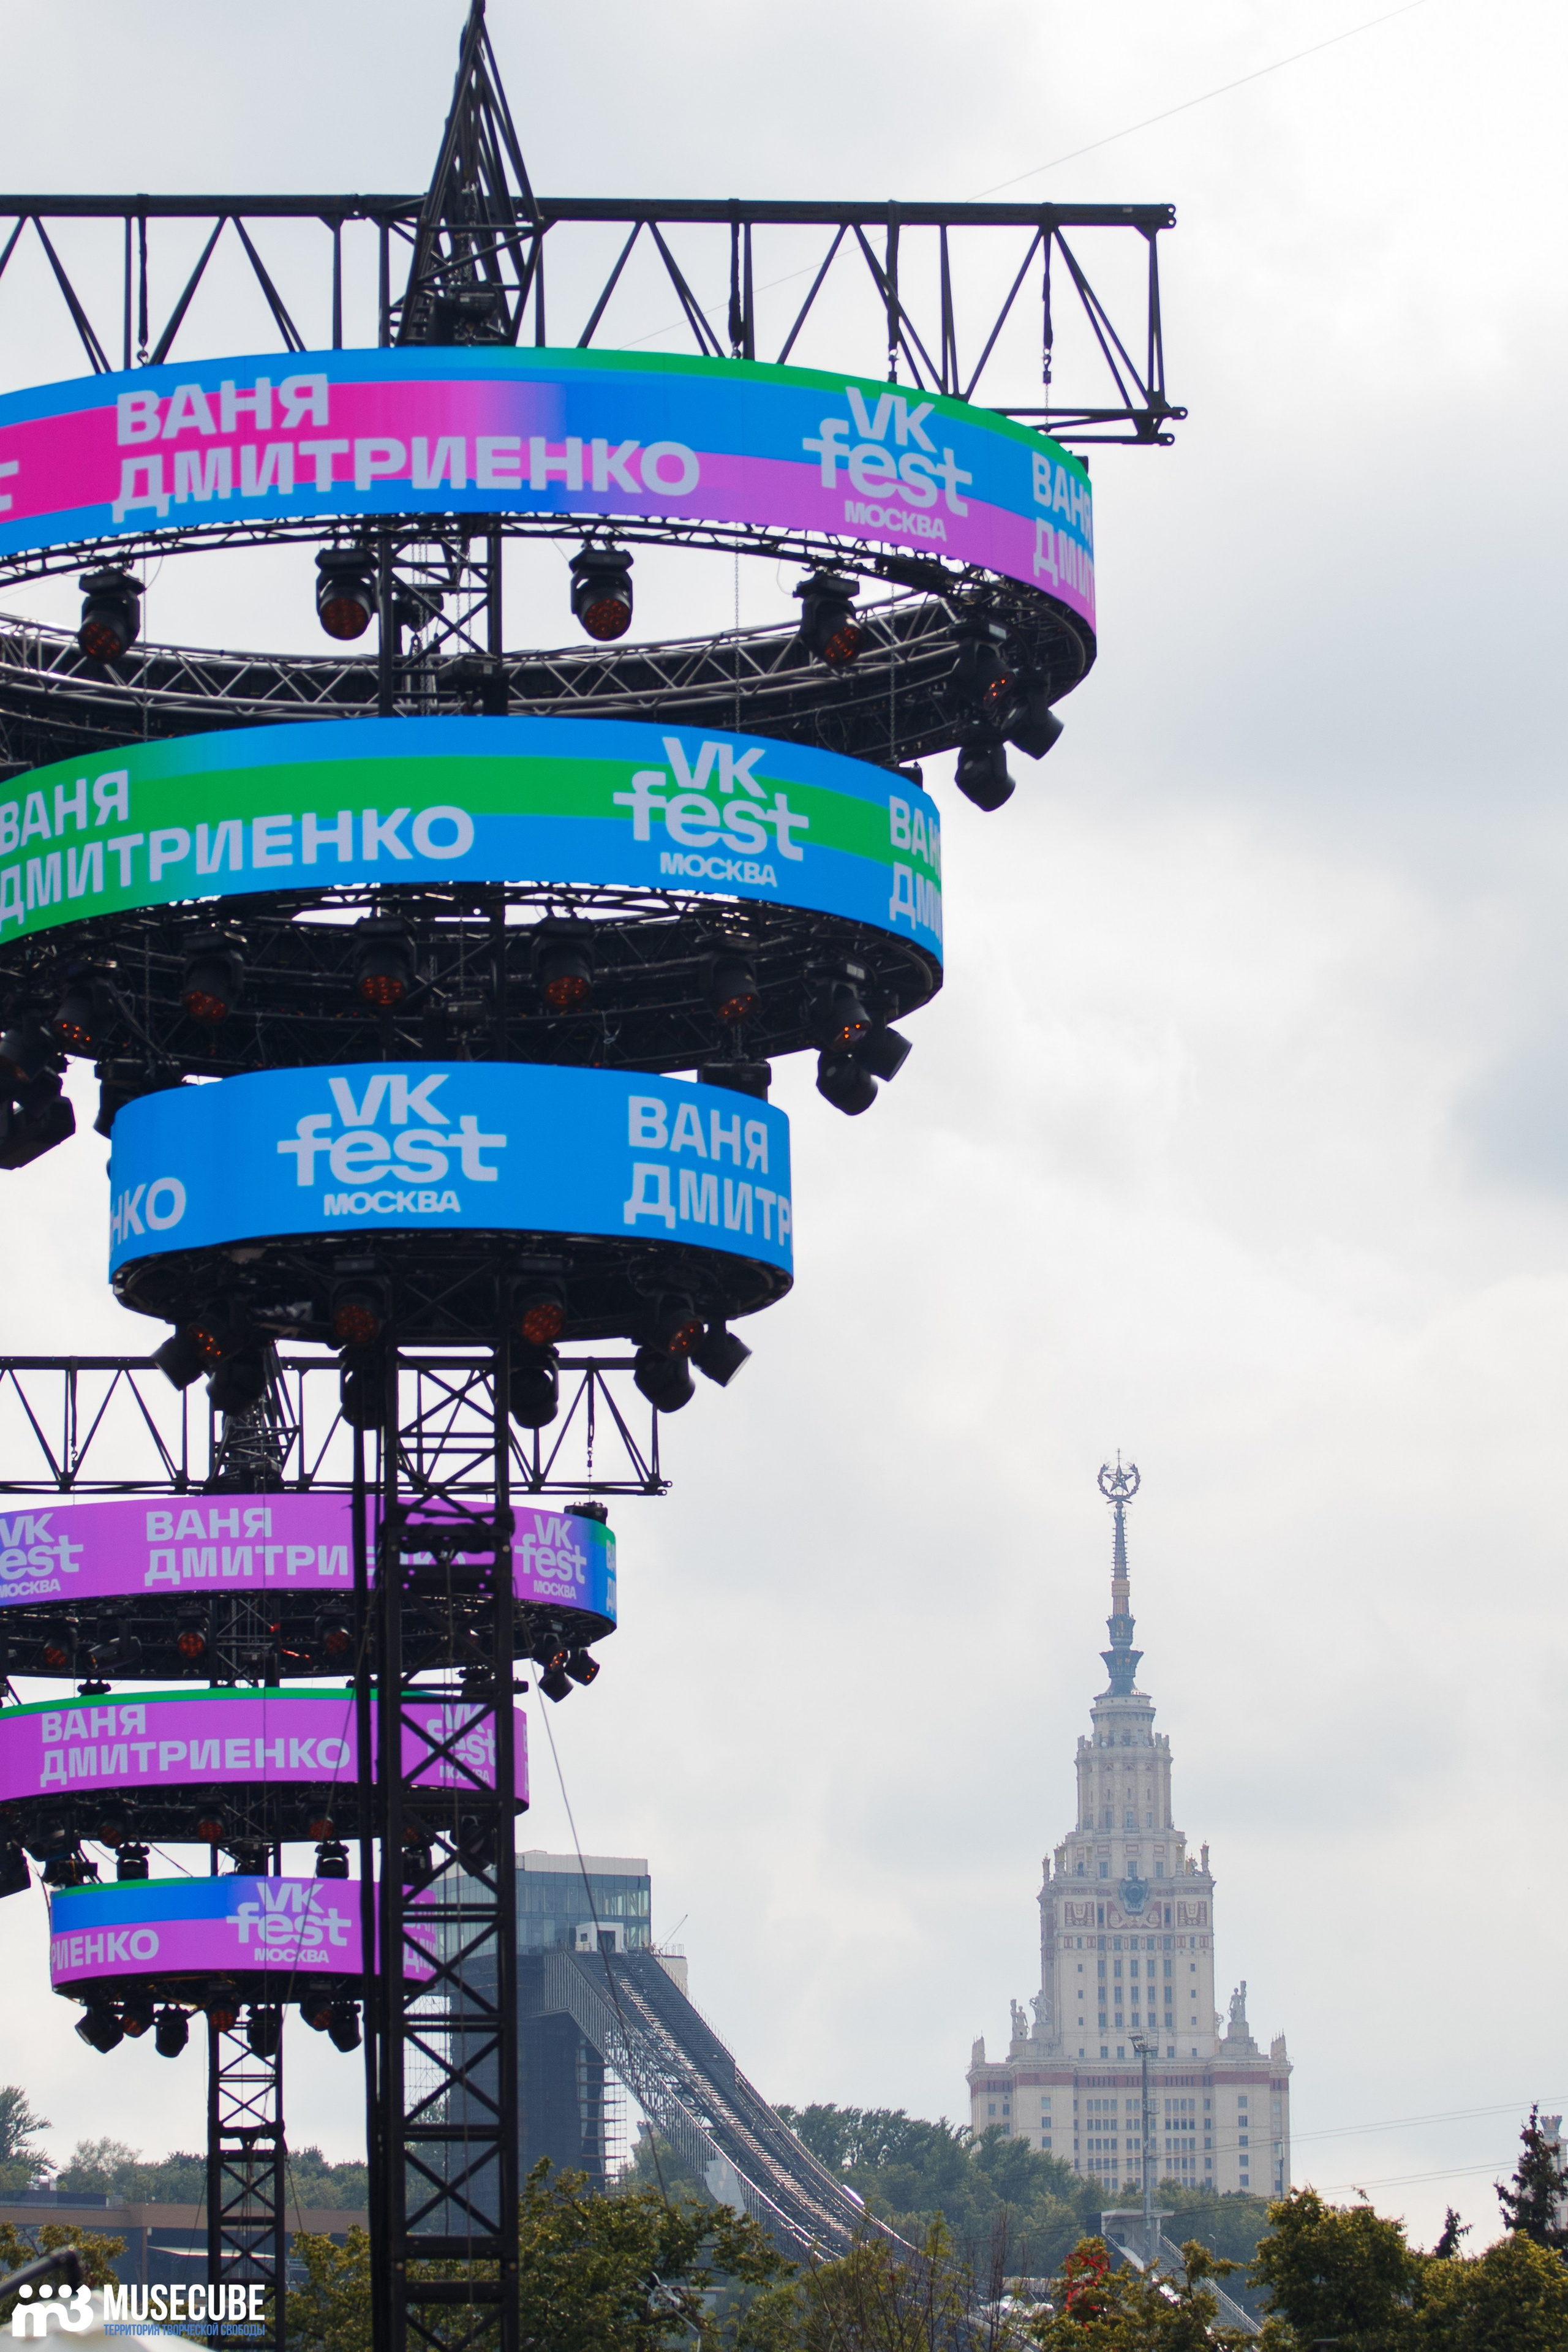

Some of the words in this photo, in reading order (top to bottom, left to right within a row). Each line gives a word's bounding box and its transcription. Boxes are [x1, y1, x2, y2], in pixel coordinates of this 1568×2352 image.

[117, 373, 329, 445] ВАНЯ
[846, 386, 935, 453] VK
[112, 435, 700, 523] ДМИТРИЕНКО
[803, 418, 973, 516] fest
[845, 500, 947, 541] МОСКВА
[662, 737, 767, 798] VK
[0, 769, 129, 855] ВАНЯ
[613, 770, 810, 861] fest
[0, 805, 475, 933] ДМИТРИЕНКО
[660, 852, 778, 888] МОСКВА
[328, 1074, 450, 1126] VK
[277, 1114, 507, 1186] fest
[628, 1095, 769, 1175] ВАНЯ
[323, 1190, 461, 1216] МОСКВА
[624, 1162, 791, 1246] ДМИТР
[146, 1507, 272, 1542] ВАНЯ
[533, 1515, 573, 1550] VK
[514, 1533, 587, 1585] fest
[533, 1580, 576, 1599] МОСКВА
[42, 1705, 146, 1743] ВАНЯ
[40, 1738, 350, 1788] ДМИТРИЕНКО
[257, 1882, 324, 1913] VK
[227, 1902, 352, 1946] fest
[254, 1948, 330, 1963] МОСКВА
